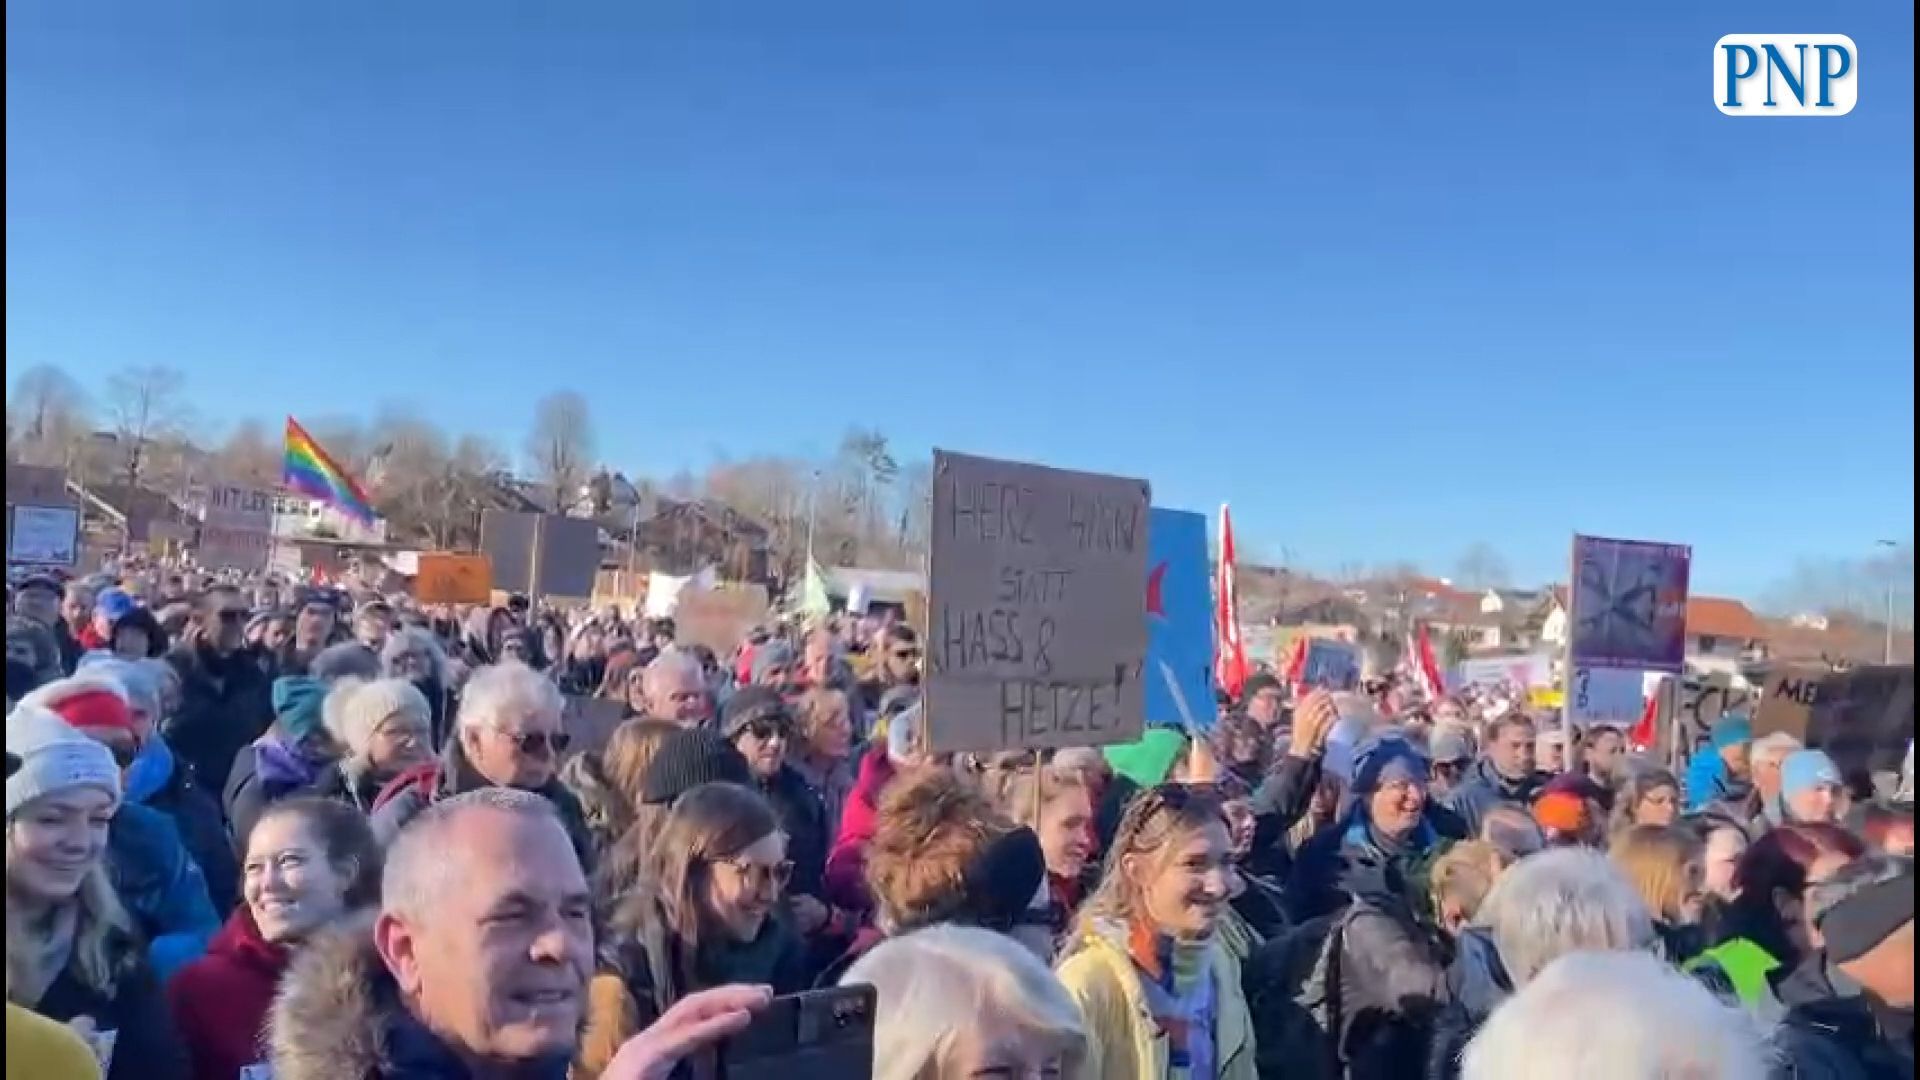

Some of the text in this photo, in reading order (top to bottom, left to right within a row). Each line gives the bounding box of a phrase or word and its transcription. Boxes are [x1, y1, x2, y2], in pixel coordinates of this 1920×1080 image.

[951, 473, 1034, 544] HERZ
[998, 566, 1075, 605] STATT
[943, 602, 1024, 671] HASS
